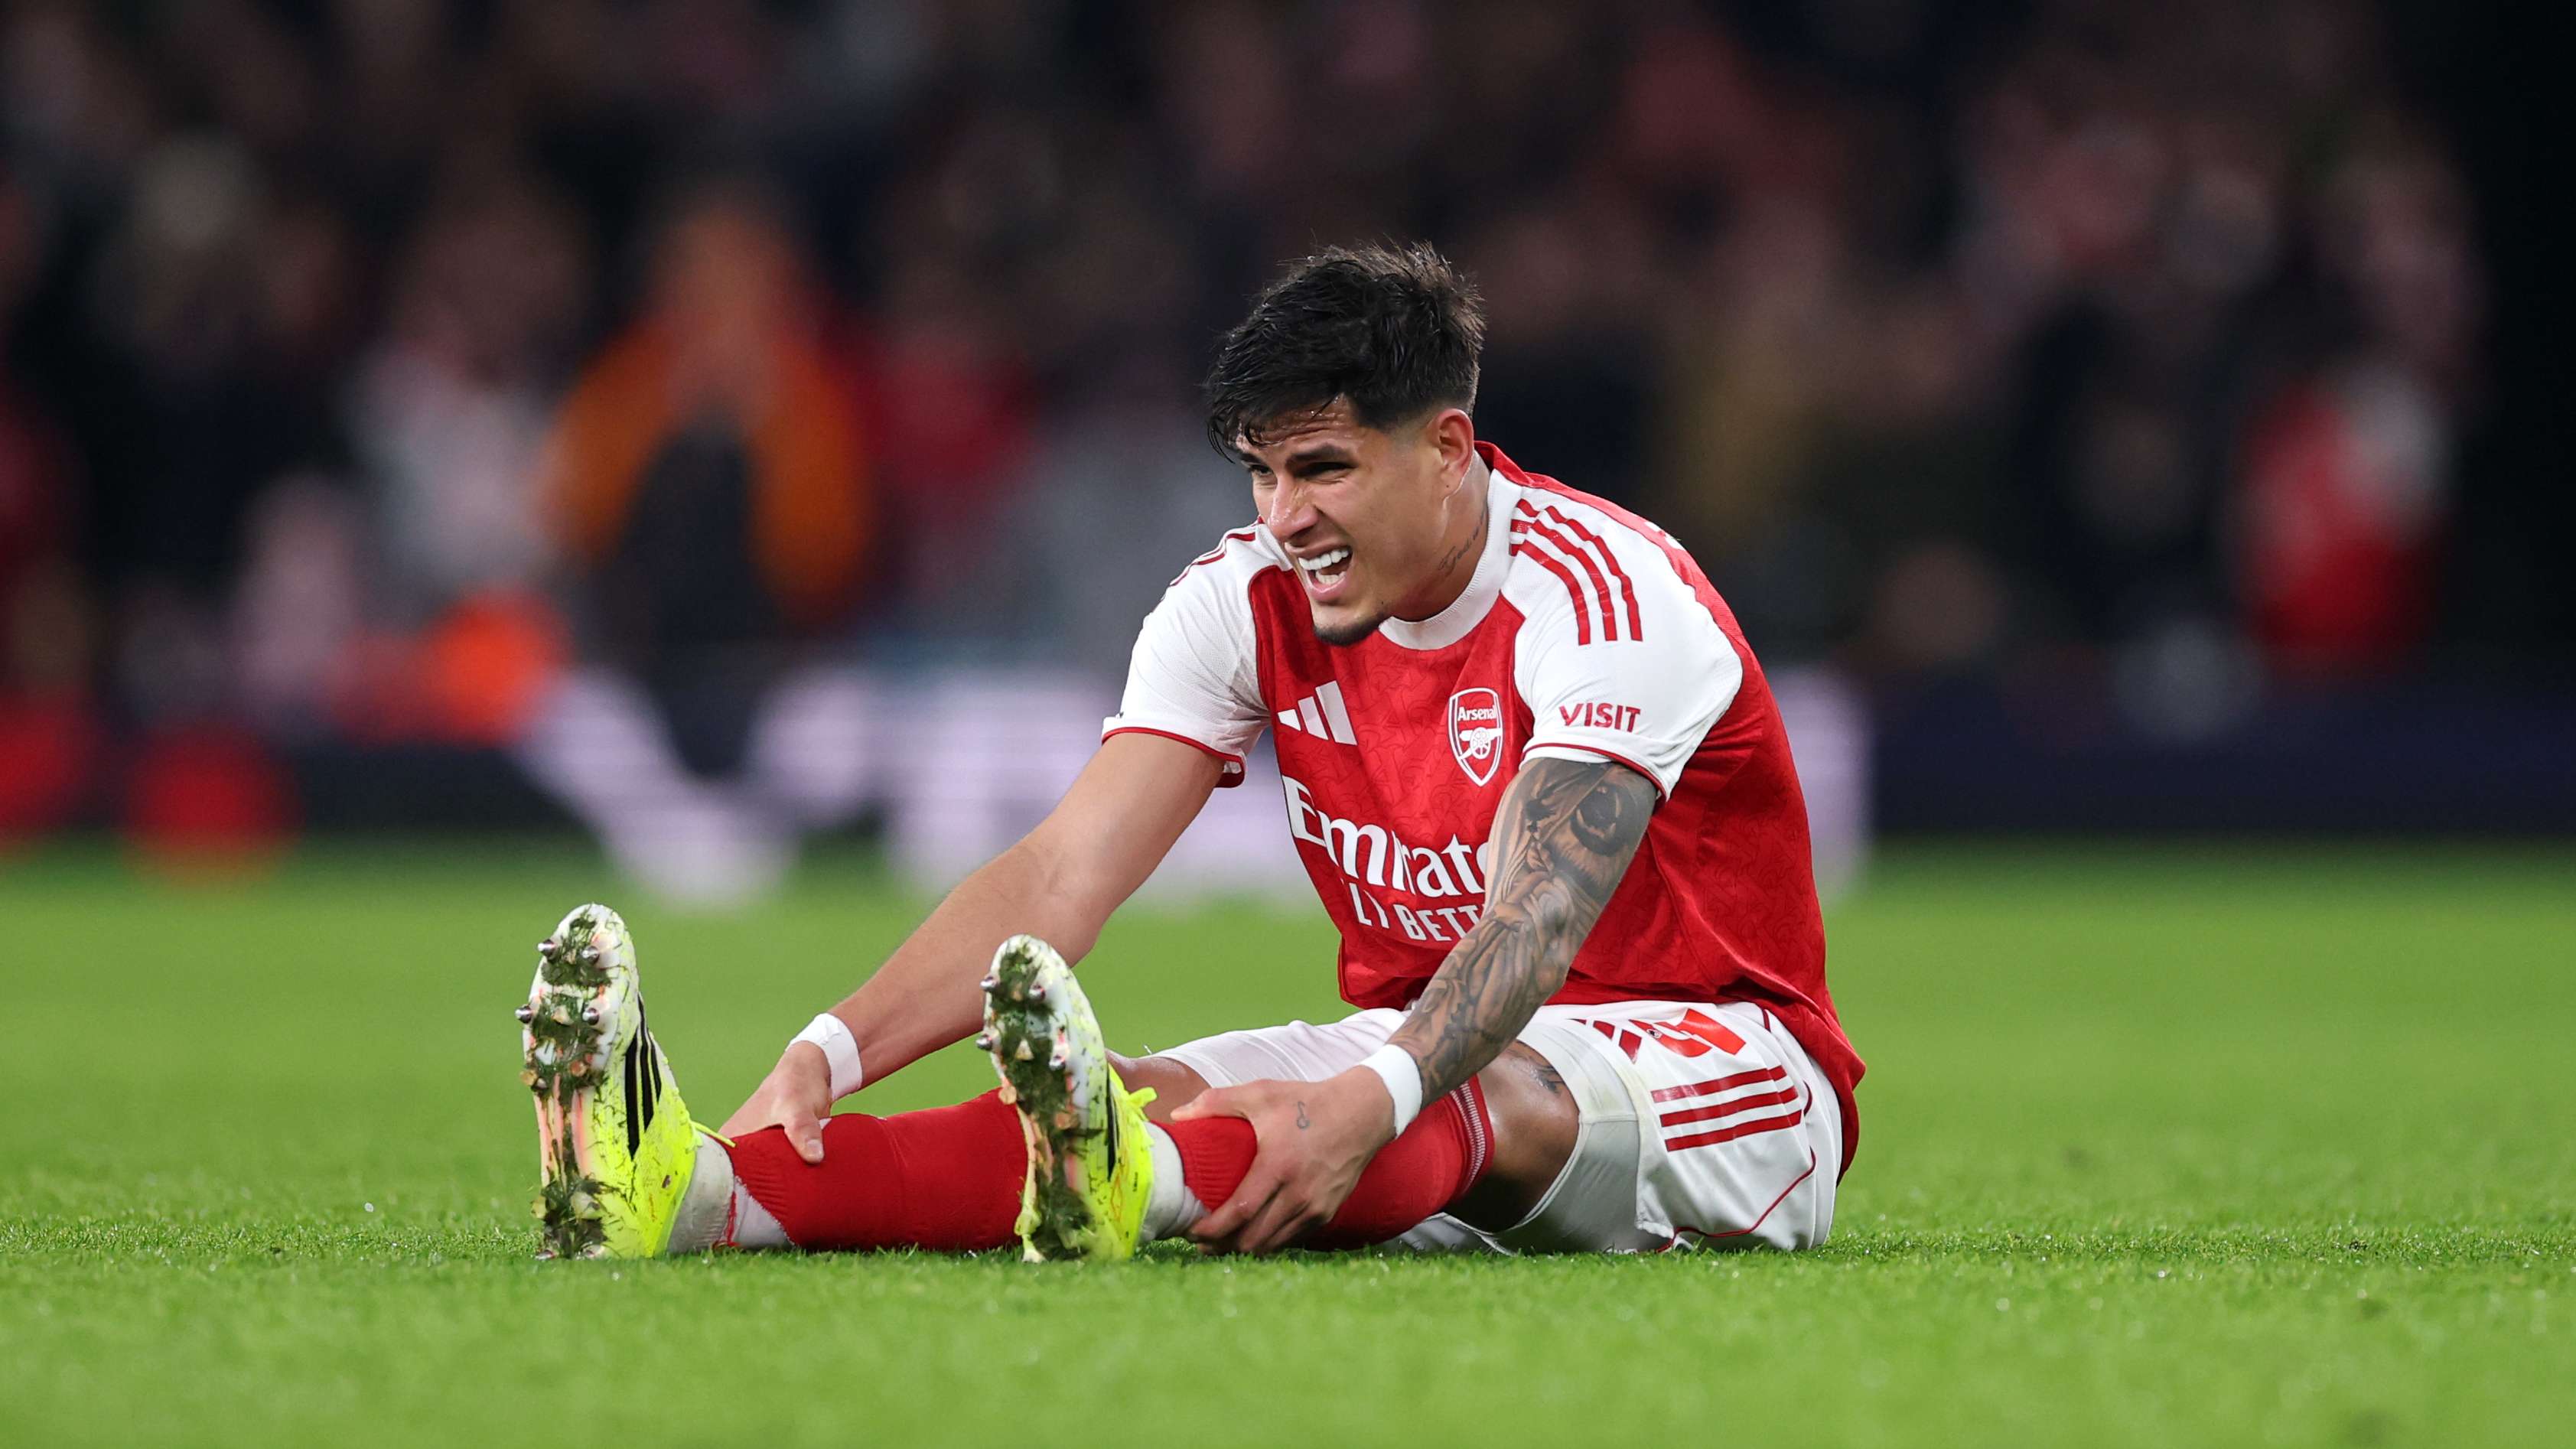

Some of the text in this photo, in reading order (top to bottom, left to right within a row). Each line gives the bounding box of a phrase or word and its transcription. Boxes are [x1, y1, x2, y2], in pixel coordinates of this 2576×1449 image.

[1457, 705, 1496, 721] Arsenal
[1559, 702, 1641, 732] VISIT
[1392, 904, 1486, 941] BETT
